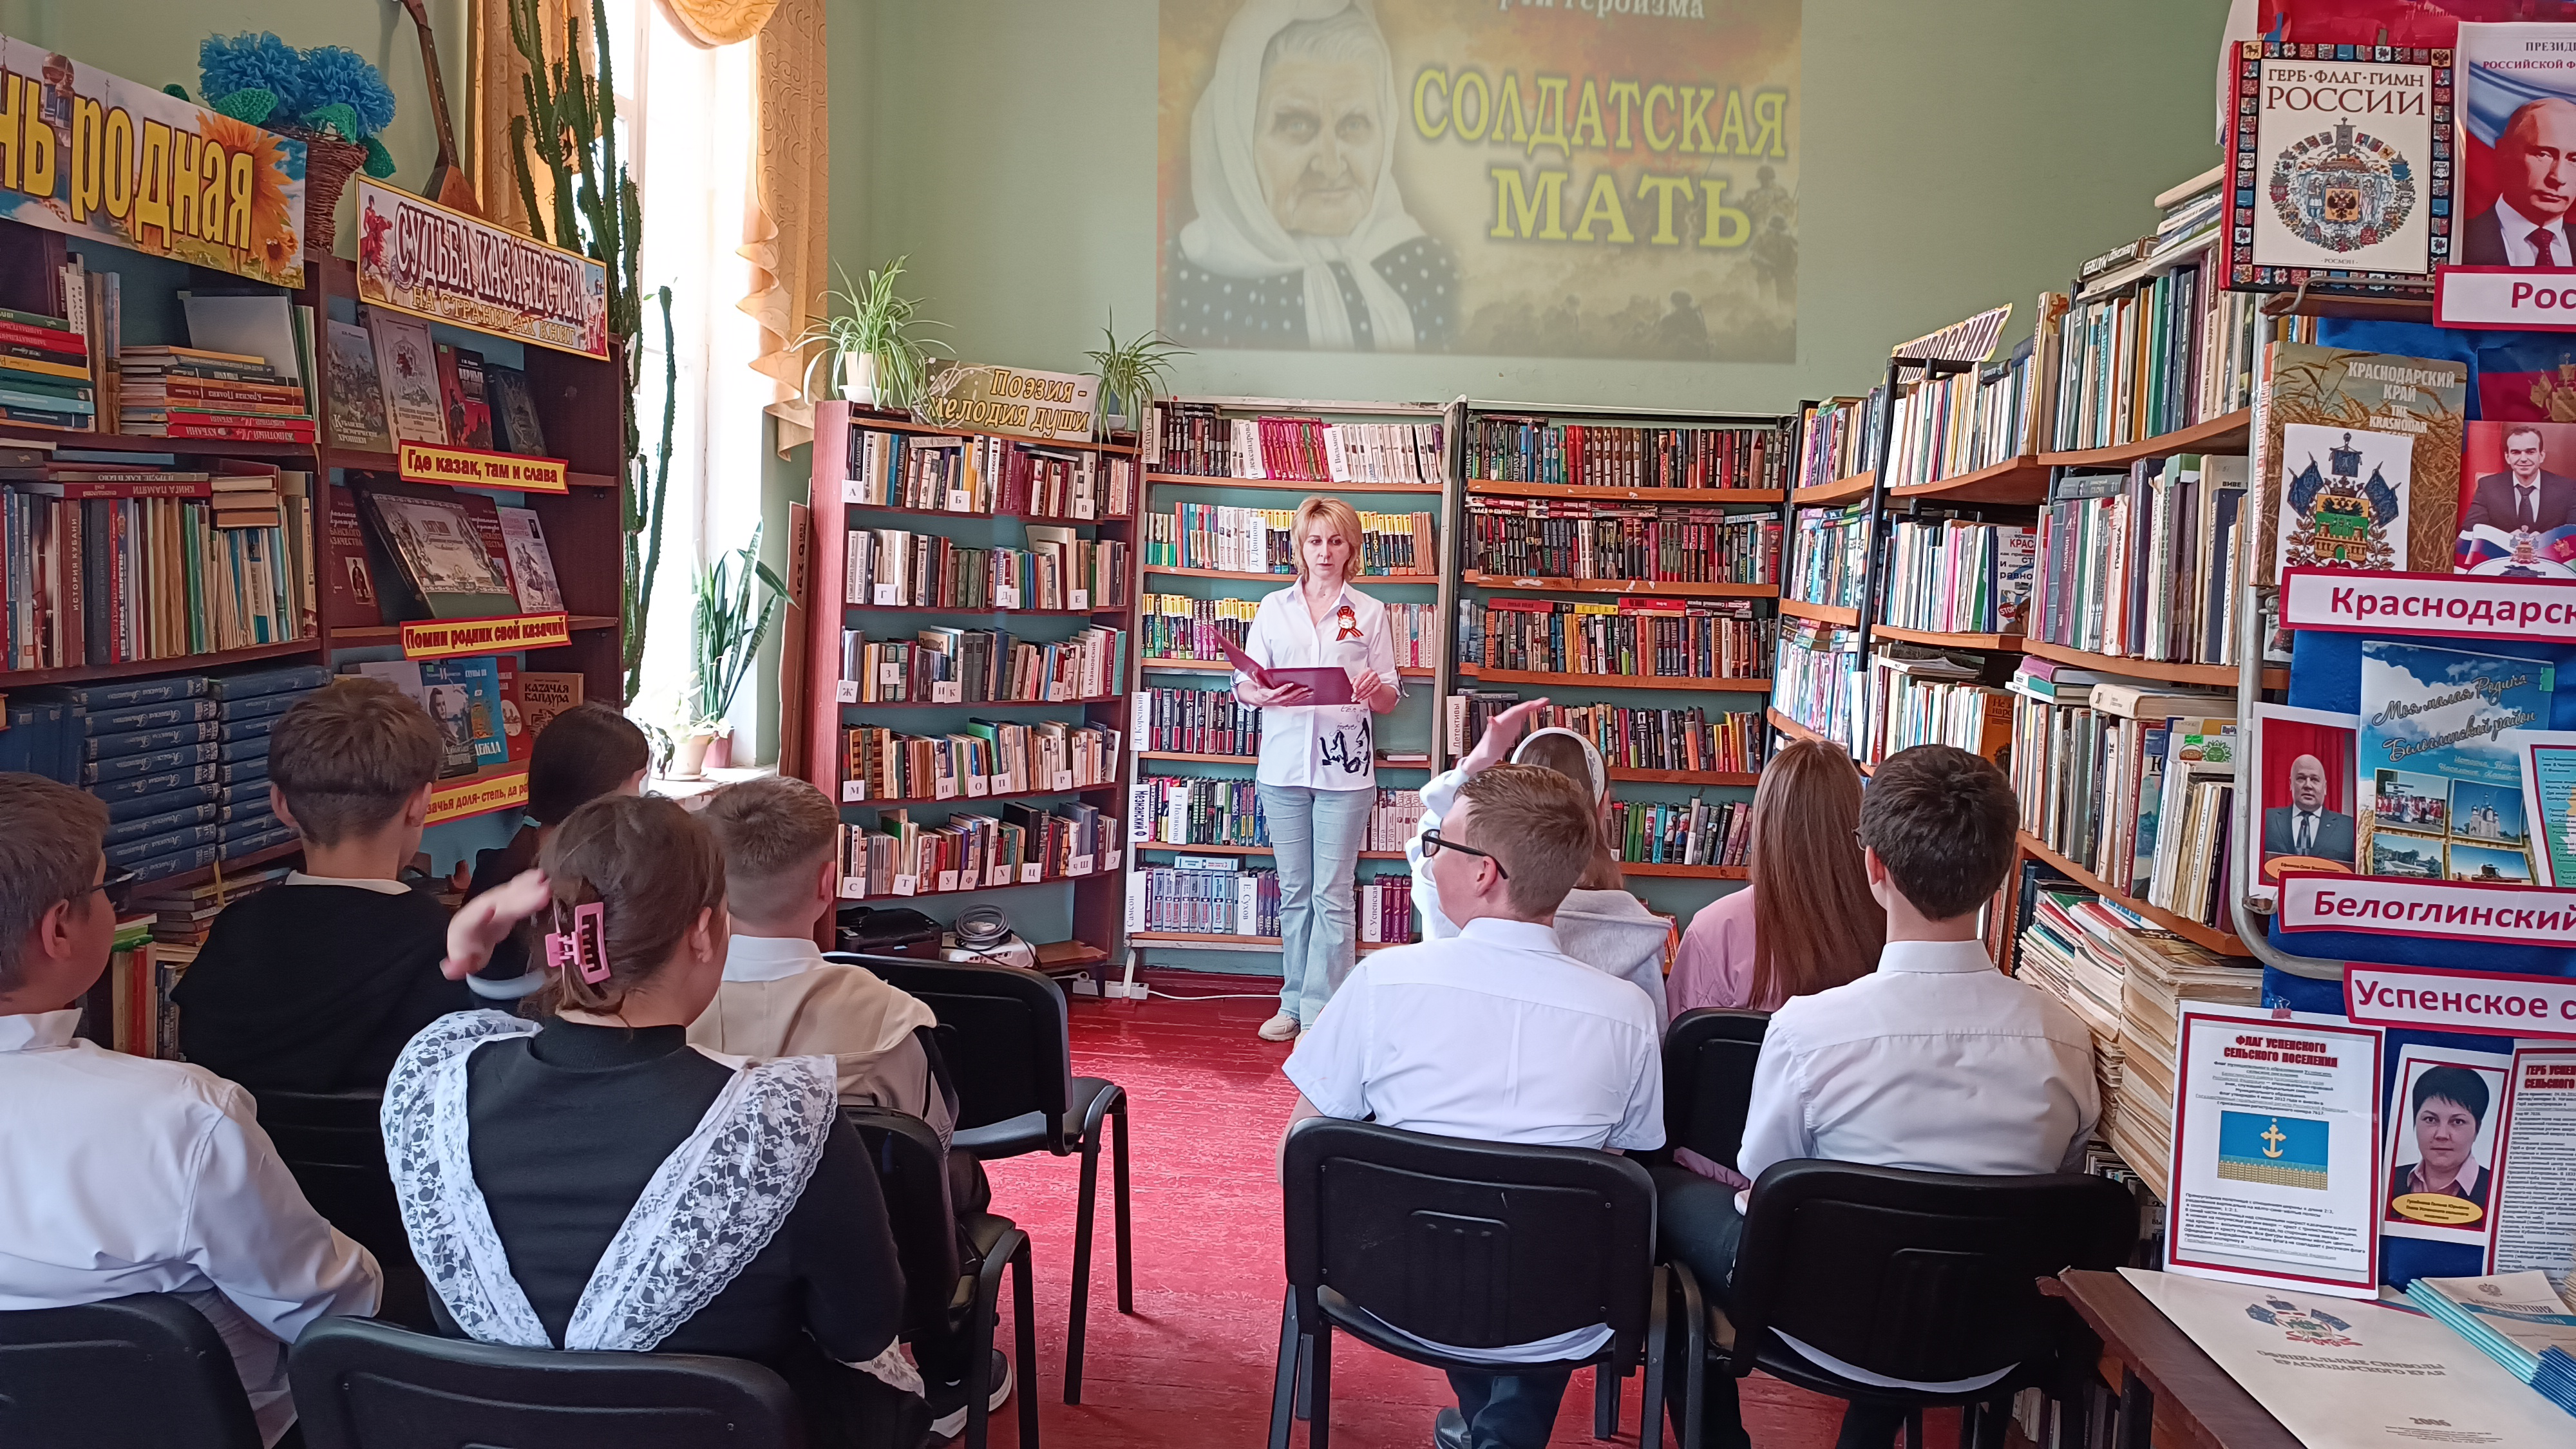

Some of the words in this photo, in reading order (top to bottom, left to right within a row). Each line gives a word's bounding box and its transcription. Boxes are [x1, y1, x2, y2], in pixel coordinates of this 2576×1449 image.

[2483, 60, 2563, 70] РОССИЙСКОЙ
[2268, 68, 2307, 83] ГЕРБ
[2314, 70, 2362, 85] ФЛАГ
[2370, 73, 2424, 88] ГИМН
[2266, 86, 2426, 116] РОССИИ
[1414, 68, 1787, 158] СОЛДАТСКАЯ
[0, 71, 56, 198] нь
[71, 94, 256, 251] родная
[1489, 168, 1752, 249] МАТЬ
[395, 201, 476, 296] СУДЬБА
[475, 231, 587, 322] КАЗАЧЕСТВА
[412, 286, 435, 312] НА
[439, 294, 537, 337] СТРАНИЦАХ
[538, 323, 576, 346] КНИГ
[2347, 361, 2456, 389] КРАСНОДАРСКИЙ
[990, 368, 1076, 402] Поэзия
[2382, 384, 2417, 403] КРАЙ
[928, 395, 1029, 429] мелодия
[1030, 407, 1090, 439] души
[2391, 404, 2409, 418] THE
[185, 426, 218, 437] КУБАНИ
[2369, 415, 2428, 434] KRASNODAR
[1331, 430, 1343, 462] Вильмонт
[407, 449, 433, 472] Где
[435, 457, 482, 480] казак,
[484, 462, 510, 479] там
[513, 466, 521, 480] и
[523, 466, 558, 483] слава
[132, 485, 167, 495] ПАМЯТИ
[169, 485, 195, 494] КНИГА
[848, 488, 857, 497] А
[955, 495, 962, 504] Б
[1250, 520, 1259, 556] Донцова
[2010, 538, 2034, 548] КРАС
[2114, 526, 2123, 570] ГРАФИКА
[1075, 595, 1081, 603] Е
[405, 628, 448, 650] Помни
[450, 627, 493, 649] родник
[494, 619, 521, 642] свой
[522, 616, 565, 639] казачий
[1485, 611, 1495, 670] РОСТОВ-ПАПА
[1088, 642, 1097, 686] Маяковский
[886, 670, 891, 678] З
[842, 687, 854, 697] Ж
[949, 688, 956, 697] К
[2372, 699, 2422, 726] Моя
[2423, 688, 2476, 712] малая
[2472, 672, 2528, 706] Родина
[1134, 694, 1144, 735] Корецкий
[1992, 705, 2014, 716] Наро
[1453, 703, 1462, 748] Детективы
[2382, 715, 2494, 762] Белоглинский
[2491, 710, 2539, 741] район
[974, 782, 982, 791] О
[998, 779, 1005, 788] П
[1059, 776, 1066, 784] Р
[482, 784, 506, 802] степь,
[506, 782, 518, 797] да
[849, 786, 860, 795] М
[1133, 790, 1149, 829] Незнанский
[1172, 803, 1182, 841] Полякова
[999, 869, 1006, 878] Х
[1028, 869, 1036, 878] Ц
[1079, 860, 1089, 869] Ш
[849, 882, 858, 892] С
[902, 878, 909, 887] Т
[945, 876, 952, 885] У
[965, 876, 973, 885] Ф
[1126, 895, 1135, 927] Самсон
[1240, 894, 1251, 920] Сухов
[1370, 887, 1379, 926] Успенская
[2354, 980, 2549, 1019] Успенское
[2235, 1035, 2263, 1047] ФЛАГ
[2266, 1037, 2327, 1054] УСПЕНСКОГО
[2224, 1047, 2279, 1062] СЕЛЬСКОГО
[2281, 1053, 2338, 1068] ПОСЕЛЕНИЯ
[2526, 1065, 2547, 1075] ГЕРБ
[2524, 1078, 2575, 1089] СЕЛЬСКОГО
[2256, 1349, 2369, 1367] ОФИЦИАЛЬНЫЕ
[2370, 1360, 2447, 1370] СИМВОЛЫ
[2272, 1358, 2406, 1376] КРАСНОДАРСКОГО
[2408, 1368, 2448, 1377] КРАЯ
[2408, 1417, 2452, 1428] 2006
